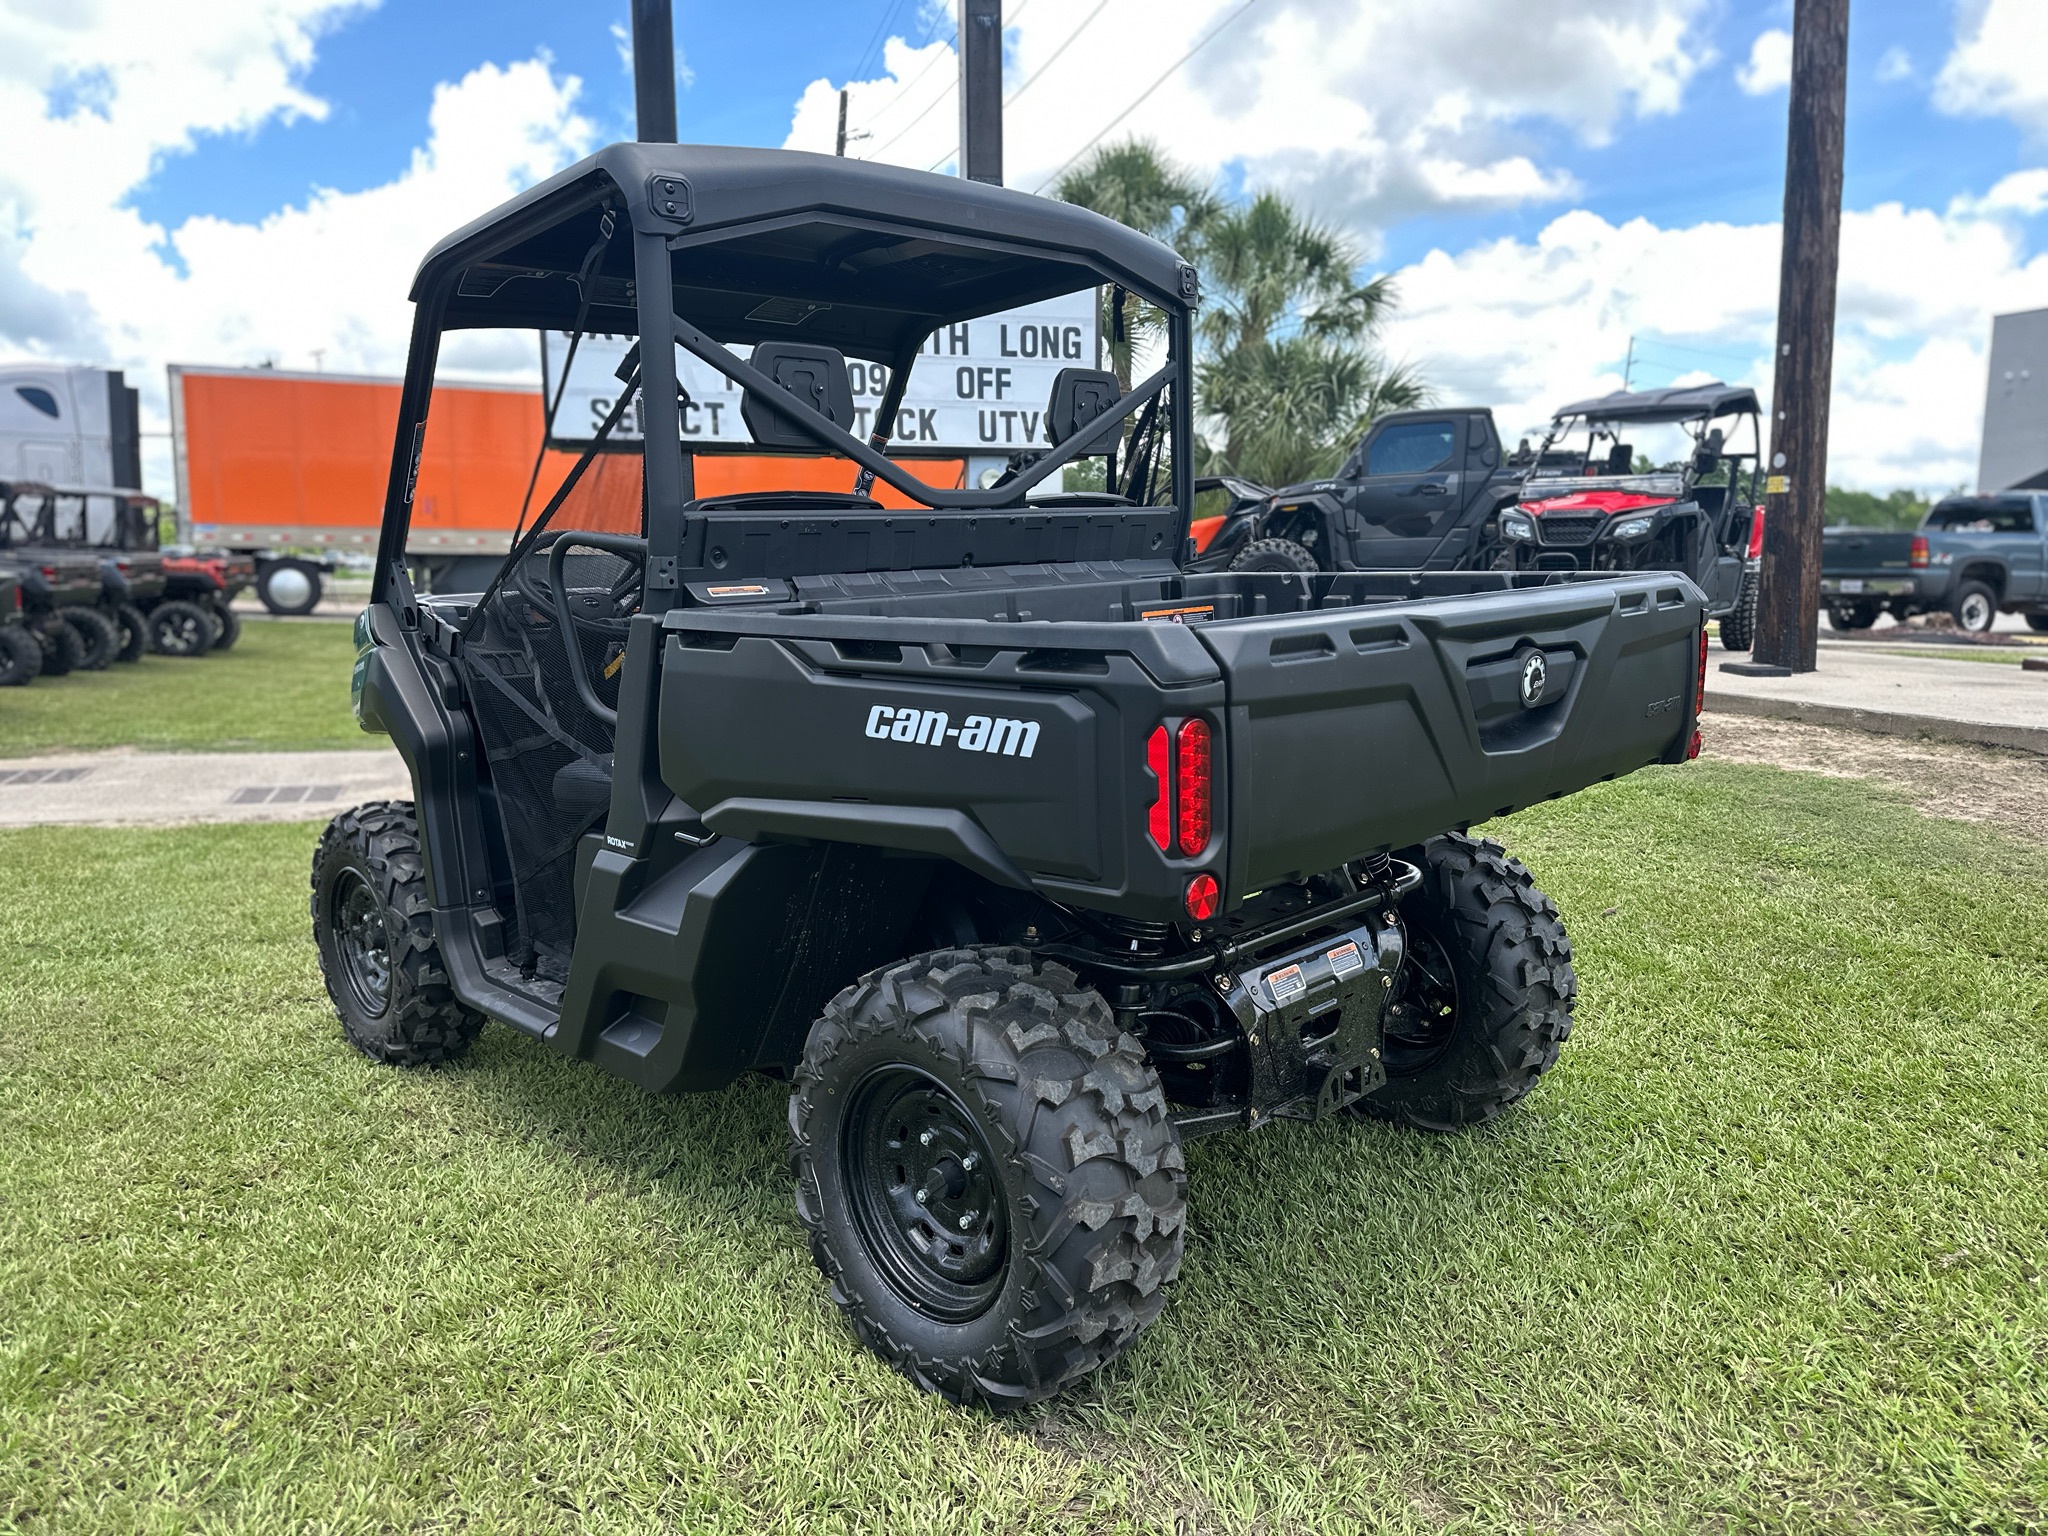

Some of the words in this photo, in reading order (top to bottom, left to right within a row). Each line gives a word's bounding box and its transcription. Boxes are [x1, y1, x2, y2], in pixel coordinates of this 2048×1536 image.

[1000, 323, 1081, 360] LONG
[956, 366, 1011, 400] OFF
[590, 398, 725, 436] SECT
[864, 704, 1041, 758] can-am
